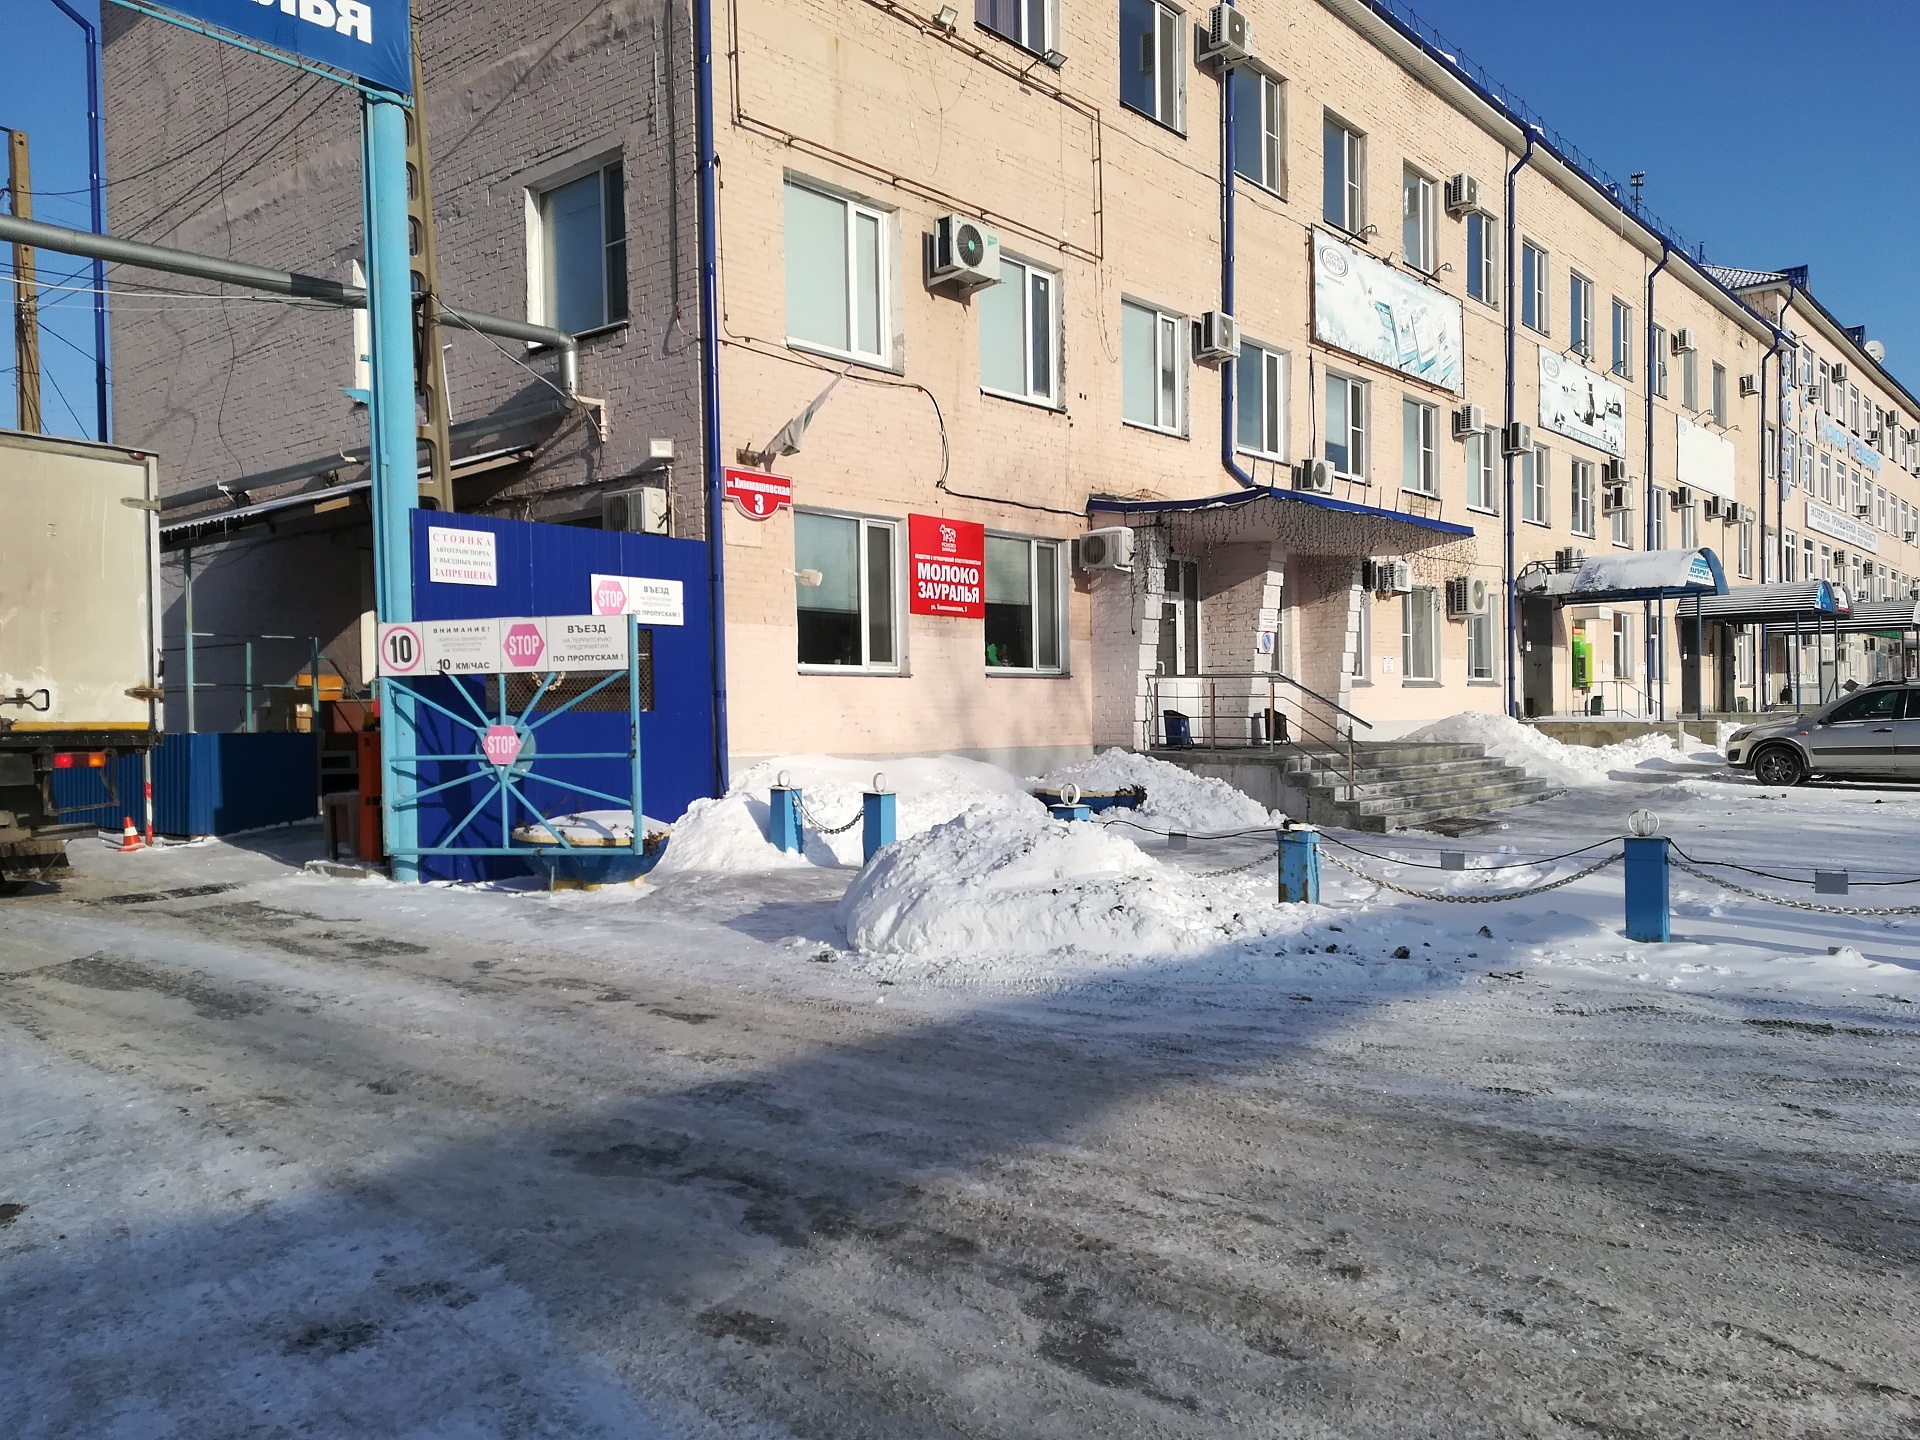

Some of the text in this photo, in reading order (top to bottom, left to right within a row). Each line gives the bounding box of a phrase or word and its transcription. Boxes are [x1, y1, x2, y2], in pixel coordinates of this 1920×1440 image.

[754, 494, 764, 514] 3
[433, 533, 491, 546] СТОЯНКА
[436, 547, 490, 556] АВТОТРАНСПОРТА
[434, 568, 492, 580] ЗАПРЕЩЕНА
[918, 562, 979, 585] МОЛОКО
[644, 586, 669, 595] ВЪЕЗД
[918, 581, 979, 603] ЗАУРАЛЬЯ
[598, 590, 623, 608] STOP
[568, 624, 606, 633] ВЪЕЗД
[390, 635, 412, 663] 10
[509, 635, 539, 655] STOP
[437, 659, 451, 670] 10
[568, 654, 619, 662] ПРОПУСКАМ
[488, 736, 516, 754] STOP
